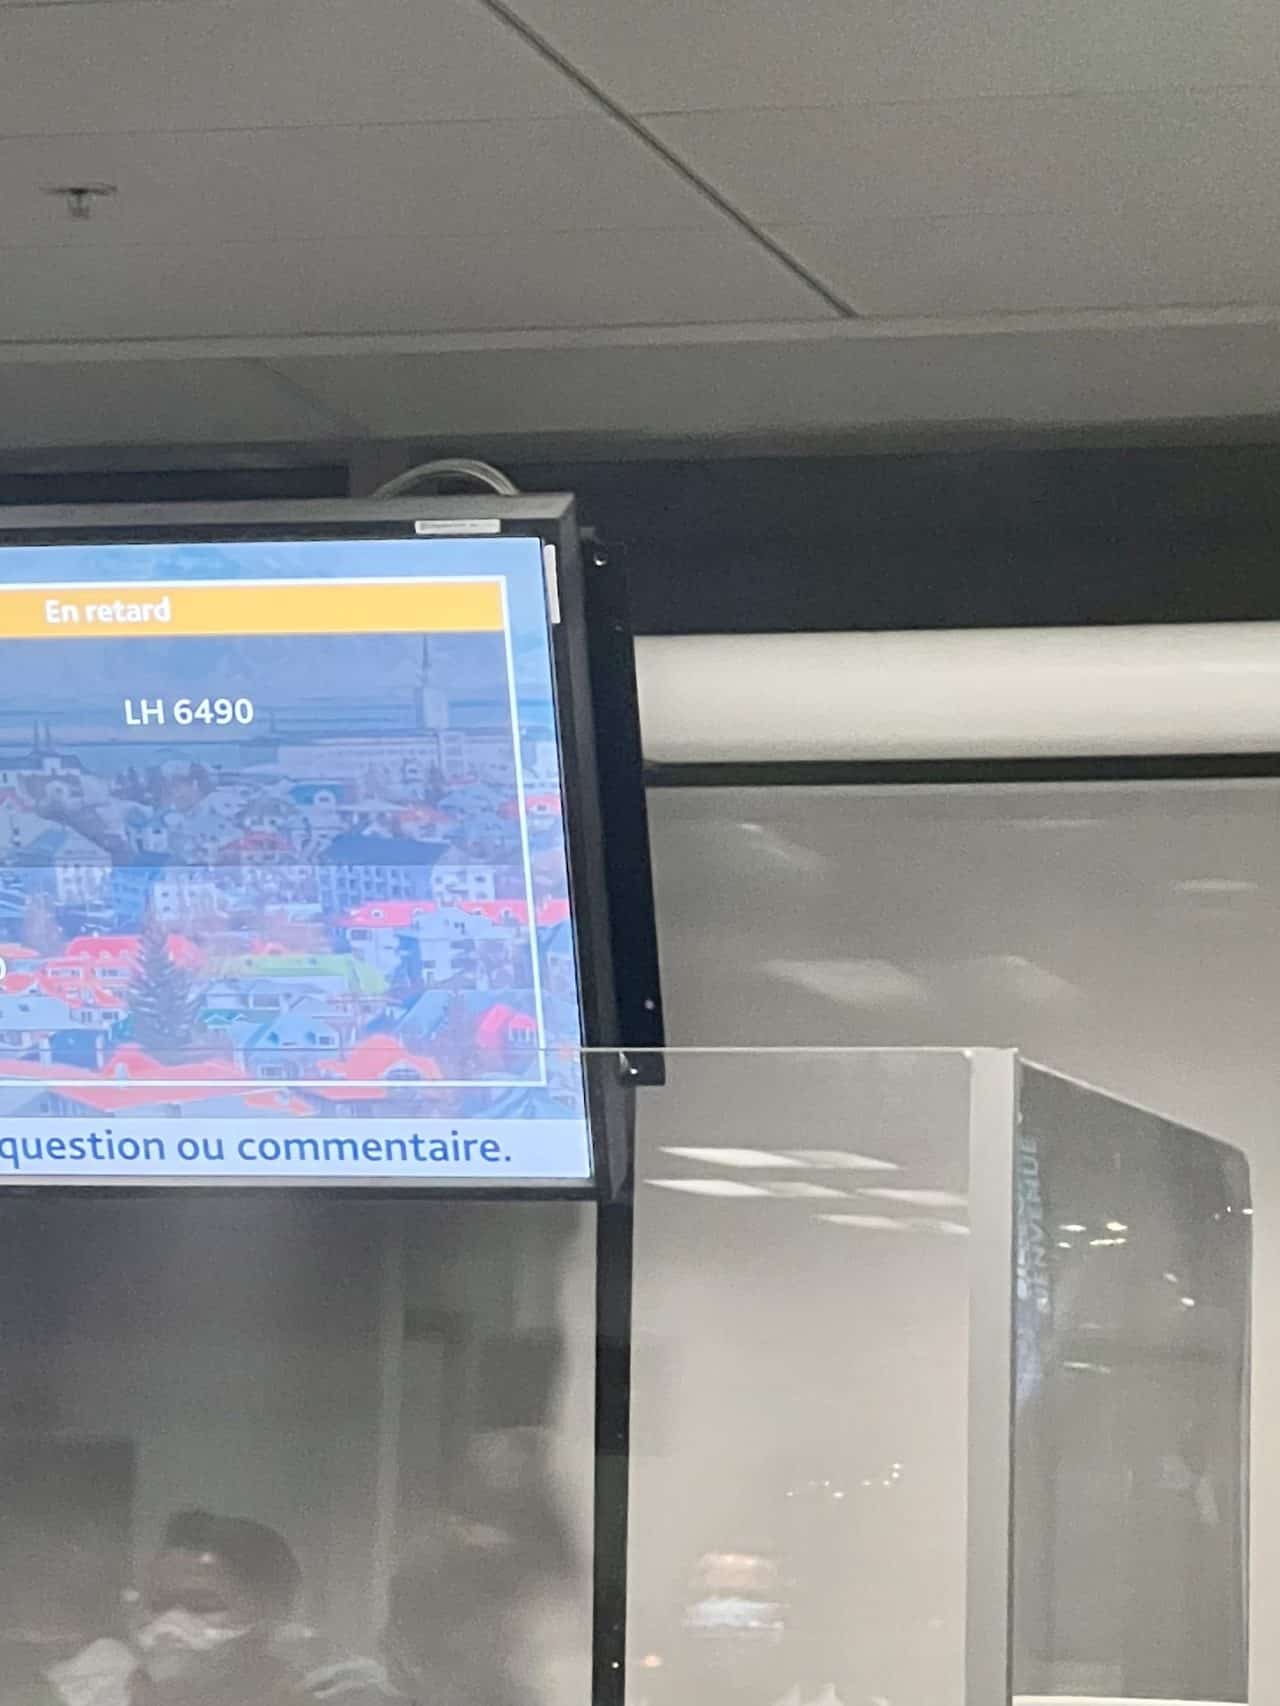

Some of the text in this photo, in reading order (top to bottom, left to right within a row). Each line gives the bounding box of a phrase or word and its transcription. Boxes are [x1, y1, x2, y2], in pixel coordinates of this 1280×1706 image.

[44, 595, 172, 623] En retard
[124, 698, 254, 725] LH 6490
[177, 1137, 224, 1161] ou
[237, 1130, 512, 1163] commentaire.
